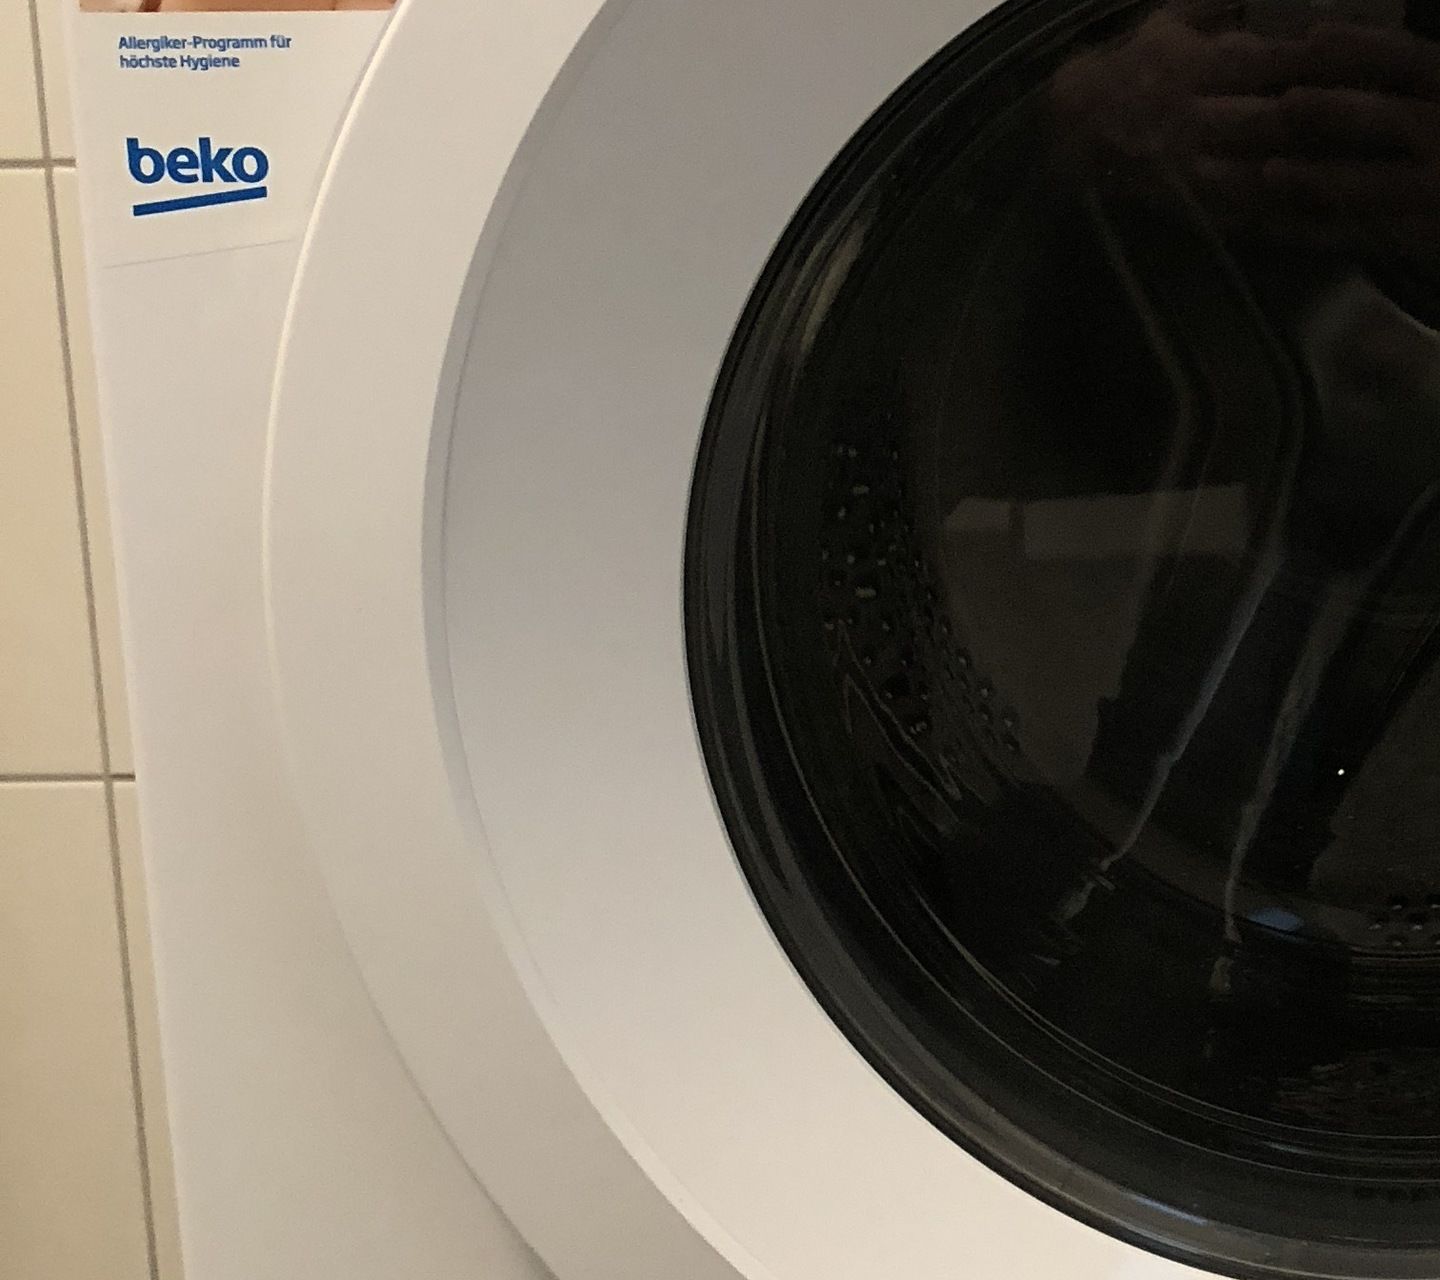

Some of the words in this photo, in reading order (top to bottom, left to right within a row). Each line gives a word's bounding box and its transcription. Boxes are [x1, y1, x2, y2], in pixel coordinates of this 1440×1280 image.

[119, 35, 267, 52] Allergiker-Programm
[271, 35, 292, 48] für
[119, 55, 177, 69] höchste
[180, 55, 240, 71] Hygiene
[126, 137, 269, 184] beko
